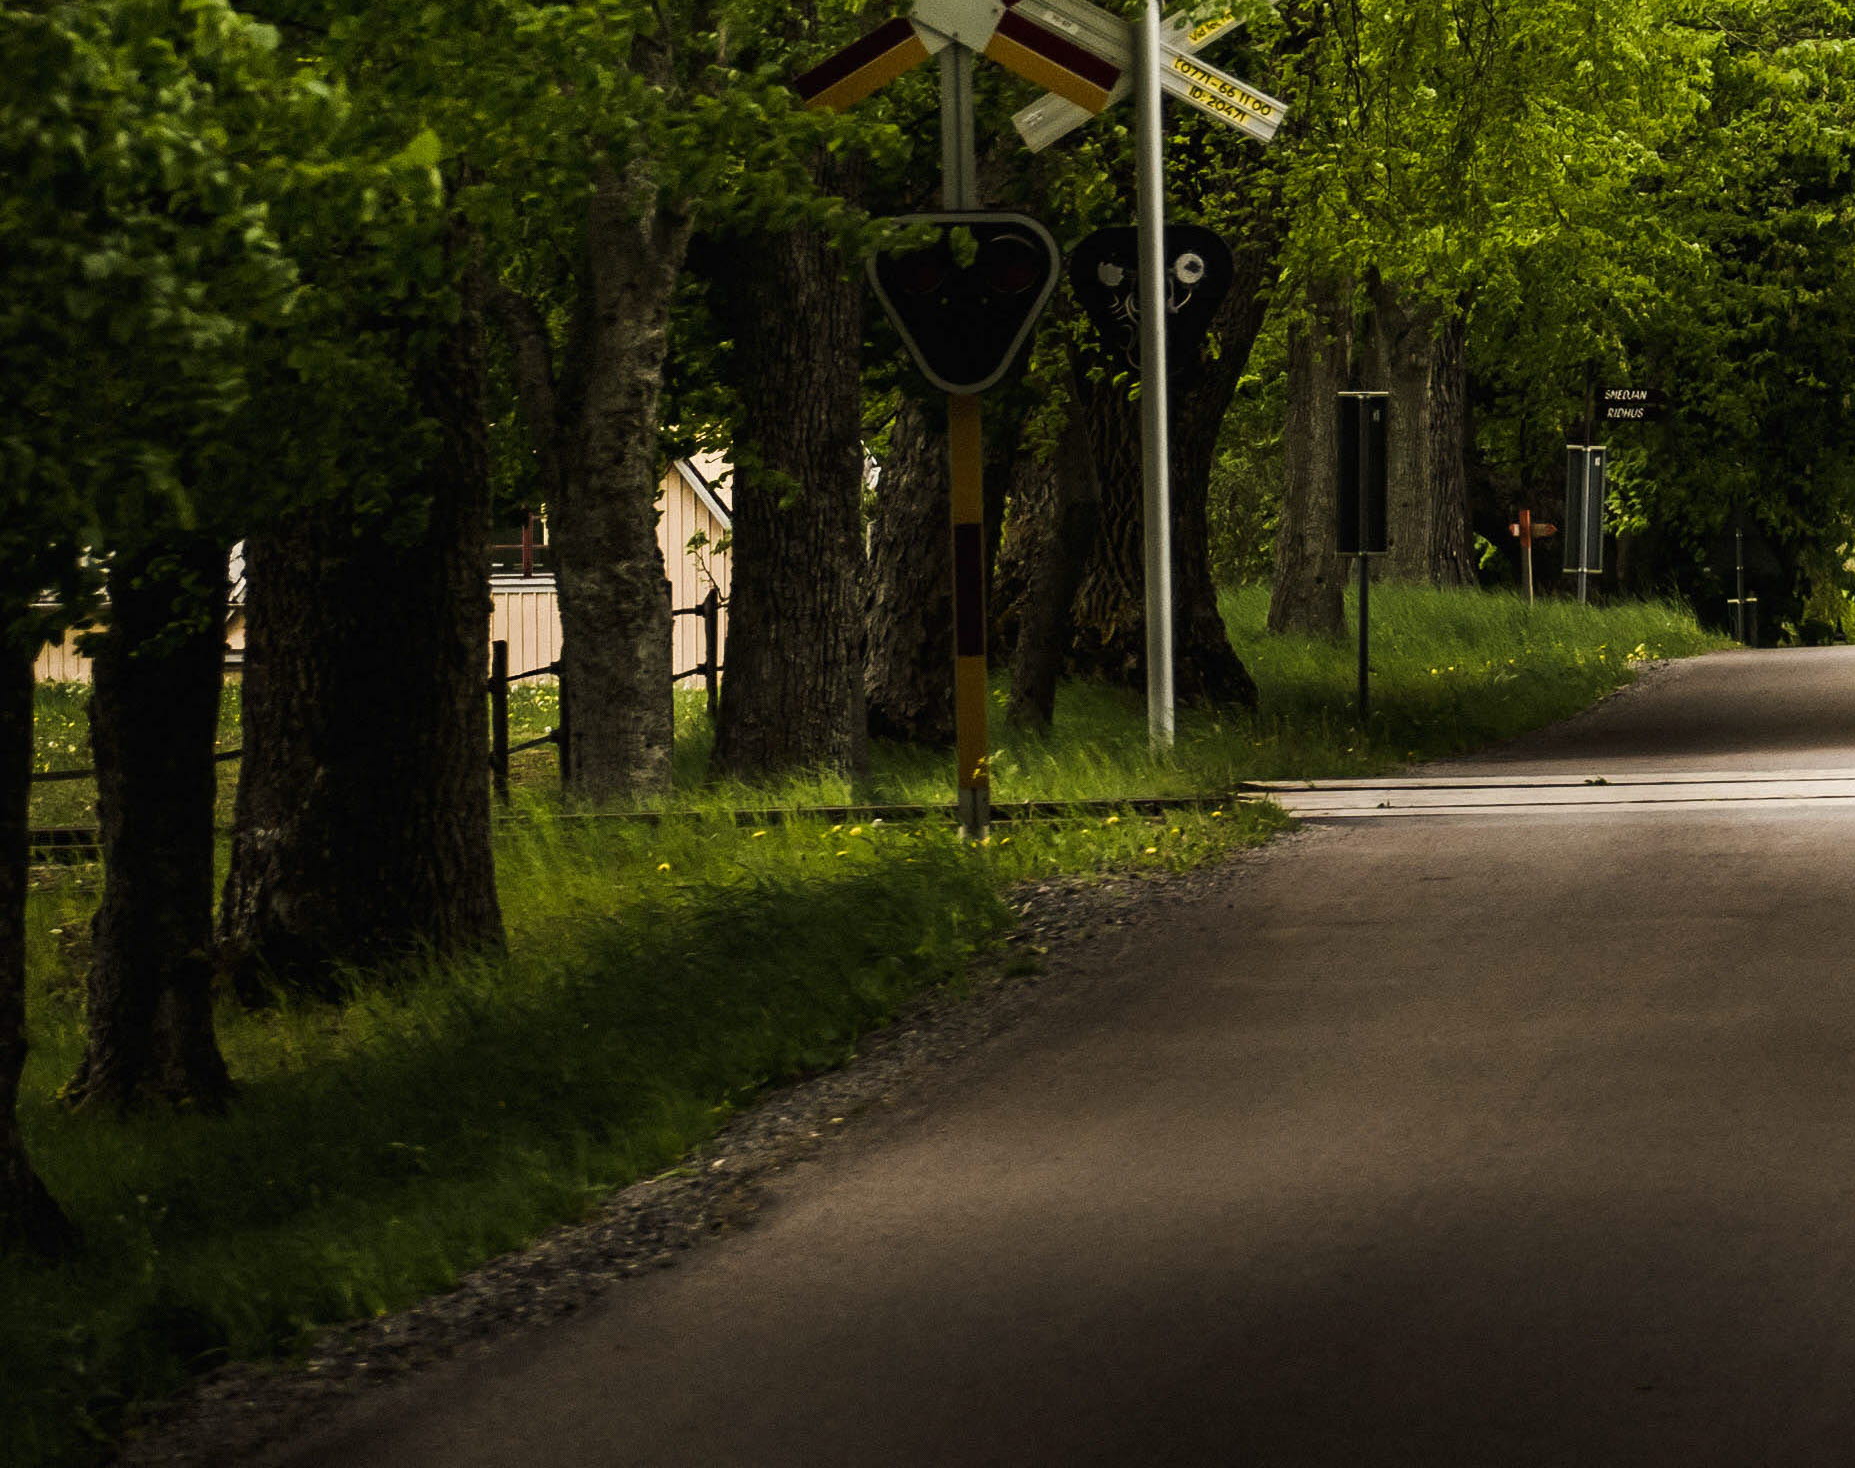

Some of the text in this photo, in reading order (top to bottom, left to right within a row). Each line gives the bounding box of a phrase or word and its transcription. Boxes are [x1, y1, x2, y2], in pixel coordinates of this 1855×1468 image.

[1181, 62, 1236, 98] 0771-66
[1251, 99, 1272, 116] 00
[1206, 96, 1247, 122] 20471
[1604, 389, 1648, 400] SMEDJAN
[1607, 407, 1645, 418] RIDHUS
